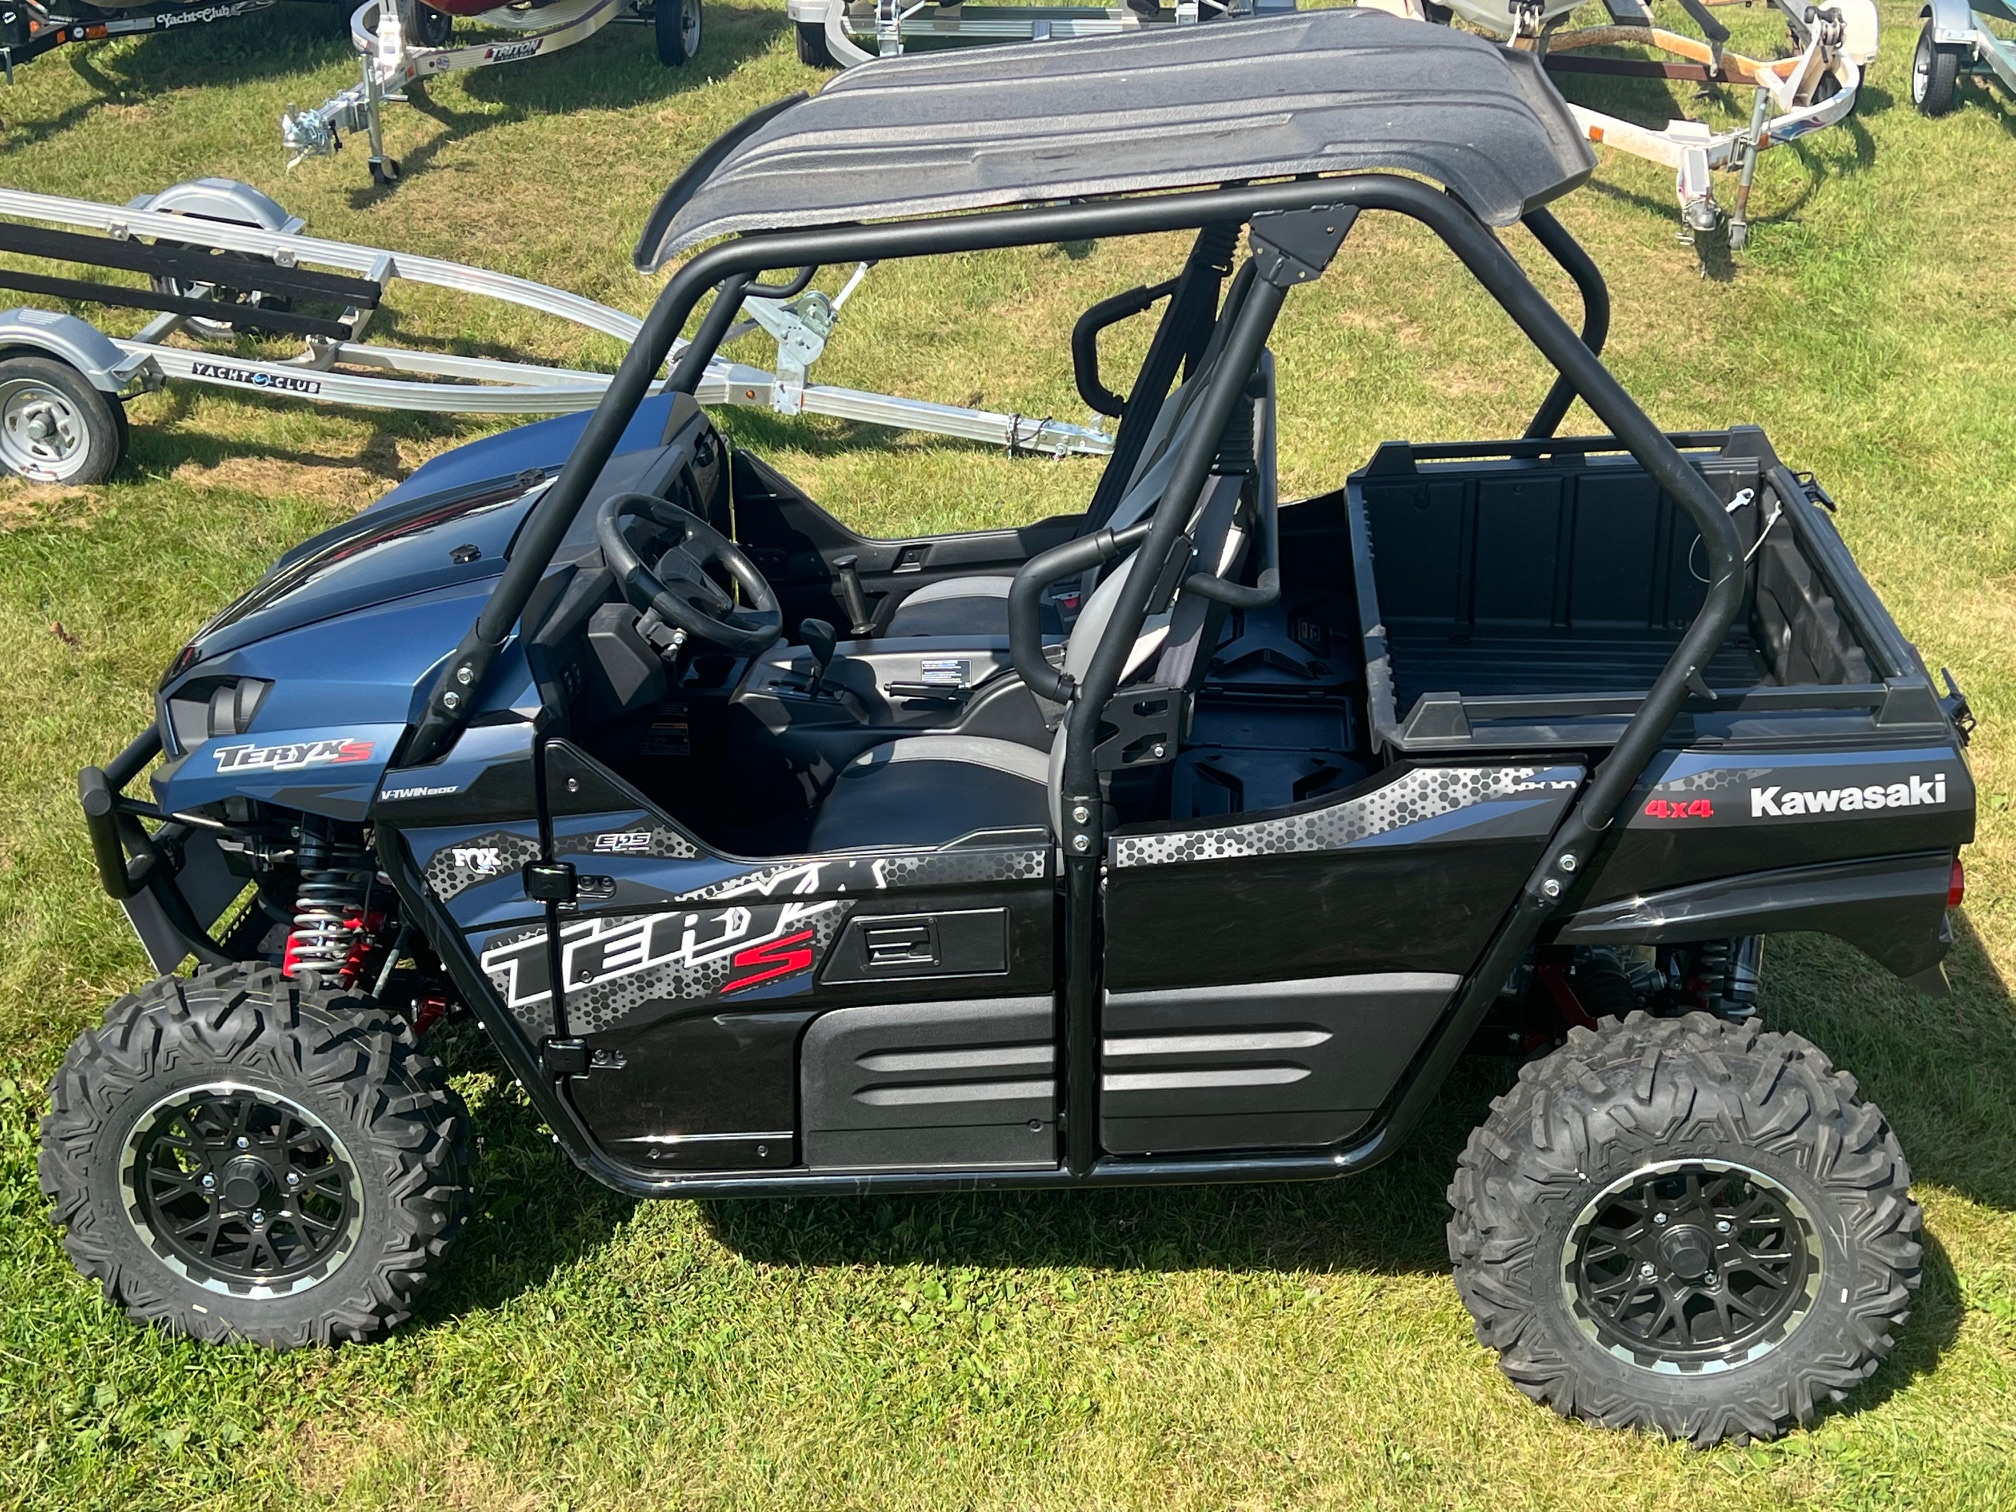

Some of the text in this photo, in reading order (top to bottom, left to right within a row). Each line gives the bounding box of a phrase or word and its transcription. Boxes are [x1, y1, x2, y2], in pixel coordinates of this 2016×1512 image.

[492, 40, 539, 58] TRITON
[195, 363, 318, 393] YACHT CLUB
[1644, 799, 1714, 819] 4x4
[1751, 773, 1946, 818] Kawasaki
[452, 847, 501, 875] FOX
